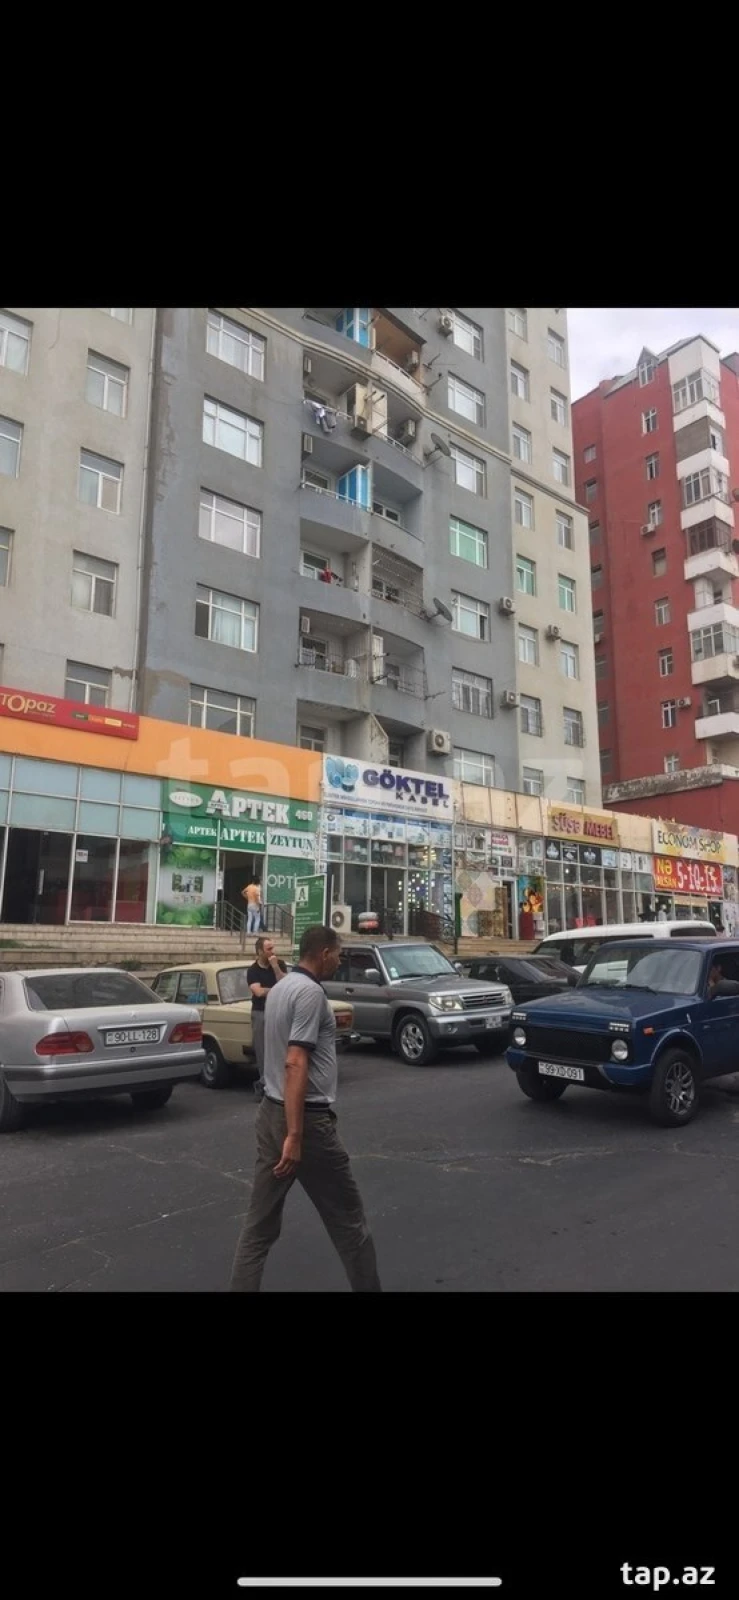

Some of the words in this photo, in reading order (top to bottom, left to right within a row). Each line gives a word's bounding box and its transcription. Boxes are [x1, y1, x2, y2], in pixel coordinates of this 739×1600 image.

[362, 768, 449, 801] GÖKTEL
[206, 789, 290, 825] APTEK
[395, 792, 449, 808] KABEL
[188, 825, 217, 837] APTEK
[220, 827, 265, 845] APTEK
[270, 834, 314, 850] ZEYTUN
[656, 858, 673, 875] NƏ
